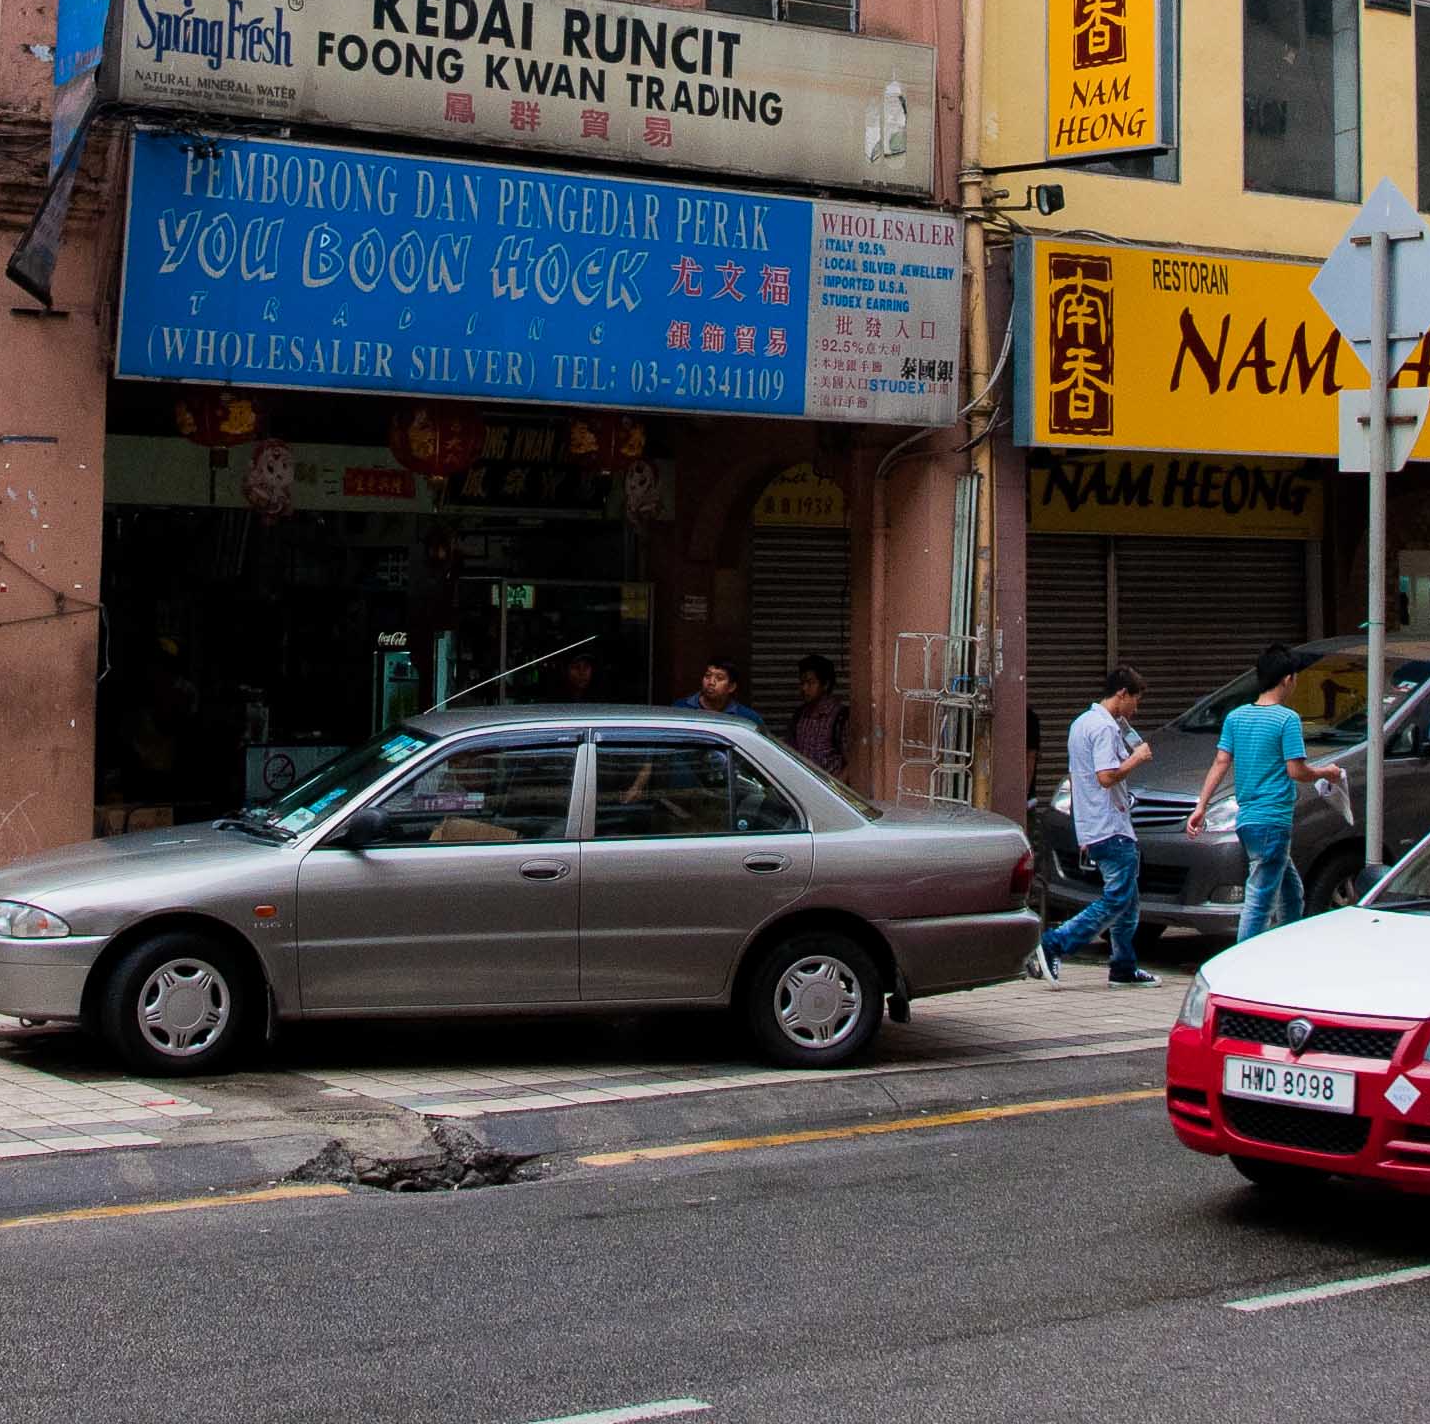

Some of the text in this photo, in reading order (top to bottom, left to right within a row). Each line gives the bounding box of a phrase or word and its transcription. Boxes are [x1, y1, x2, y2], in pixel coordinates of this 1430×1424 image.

[562, 7, 741, 79] RUNCIT
[134, 69, 297, 101] NATURAL MINERAL WATER
[317, 30, 784, 126] FOONG KWAN TRADING
[1069, 75, 1132, 109] NAM
[1055, 109, 1147, 148] HEONG
[182, 146, 772, 252] PEMBORONG DAN PENGEDAR PERAK
[821, 212, 956, 247] WHOLESALER
[858, 241, 886, 256] 92.5%
[157, 207, 649, 313] YOU BOON HOCK
[862, 260, 896, 275] SILVER
[900, 264, 955, 281] JEWELLERY
[1152, 258, 1229, 296] RESTORAN
[822, 294, 910, 312] STUDEX EARRING
[878, 279, 908, 295] U.S.A.
[1049, 266, 1114, 421] 南香
[1169, 306, 1344, 396] NAM
[147, 325, 786, 401] (WHOLESALER SILVER) TEL: 03-20341109
[1042, 459, 1312, 515] NAM HEONG
[1240, 1063, 1335, 1101] HWD 8098
